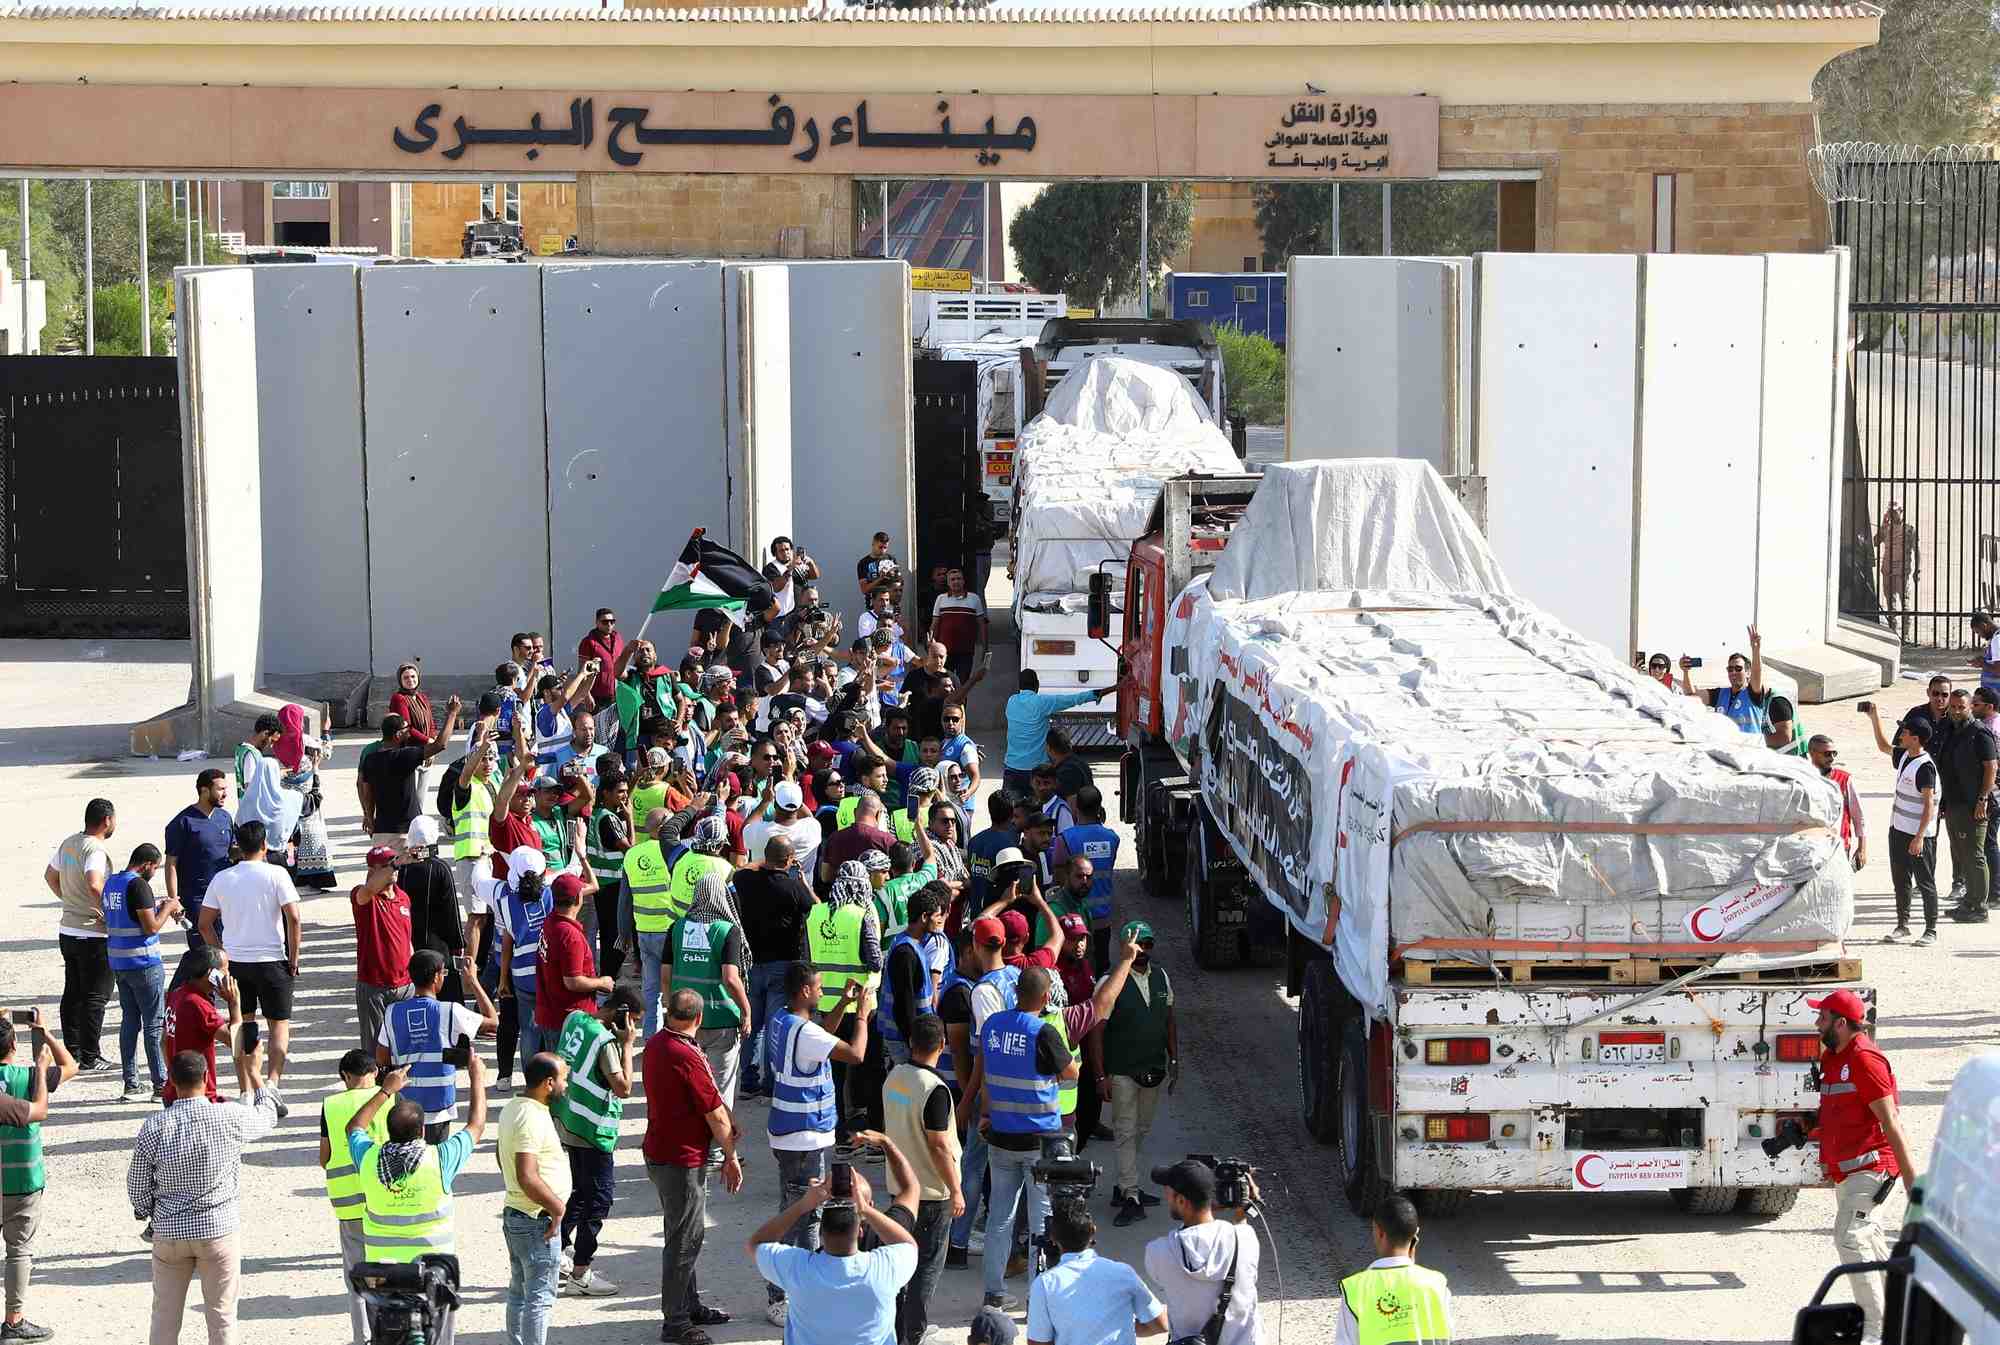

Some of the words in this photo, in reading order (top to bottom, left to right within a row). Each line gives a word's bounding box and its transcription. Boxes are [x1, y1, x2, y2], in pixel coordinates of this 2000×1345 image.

[1281, 101, 1325, 127] النقل
[1331, 102, 1377, 127] وزارة
[608, 94, 820, 167] رفح
[830, 99, 1037, 166] ميناء
[1312, 131, 1349, 146] العامة
[1351, 131, 1388, 149] الهيئة
[1268, 152, 1337, 170] والجافة
[1341, 152, 1389, 171] البرية
[1661, 1159, 1684, 1169] الهلال
[1608, 1171, 1638, 1180] EGYPTIAN
[1639, 1171, 1652, 1179] RED
[1653, 1171, 1683, 1179] CRESCENT
